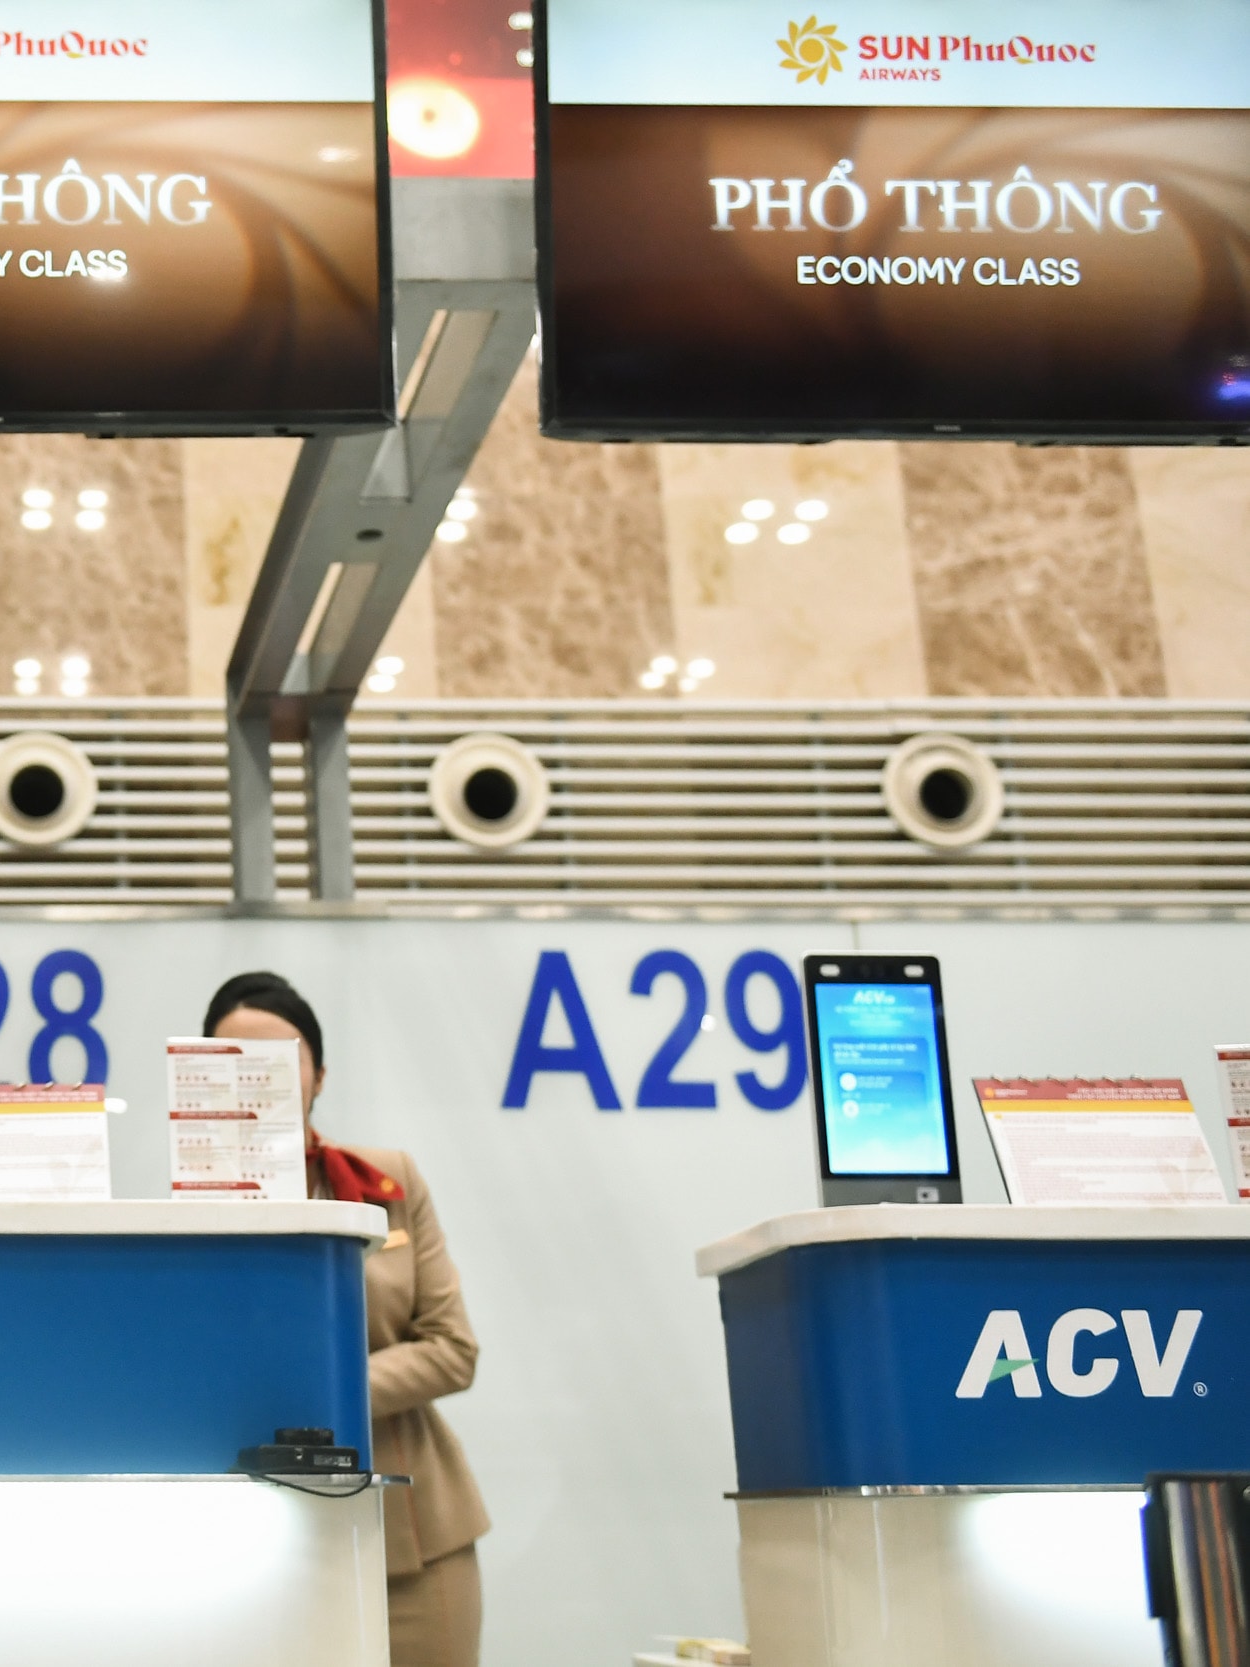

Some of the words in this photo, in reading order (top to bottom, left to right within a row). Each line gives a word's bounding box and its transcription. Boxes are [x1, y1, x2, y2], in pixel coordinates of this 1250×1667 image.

[859, 35, 930, 61] SUN
[938, 35, 1096, 65] PhuQuoc
[859, 68, 942, 81] AIRWAYS
[708, 159, 868, 233] PHỔ
[884, 165, 1163, 235] THÔNG
[19, 249, 128, 279] CLASS
[796, 255, 966, 286] ECONOMY
[972, 257, 1081, 287] CLASS
[501, 948, 809, 1112] A29
[955, 1308, 1203, 1398] ACV
